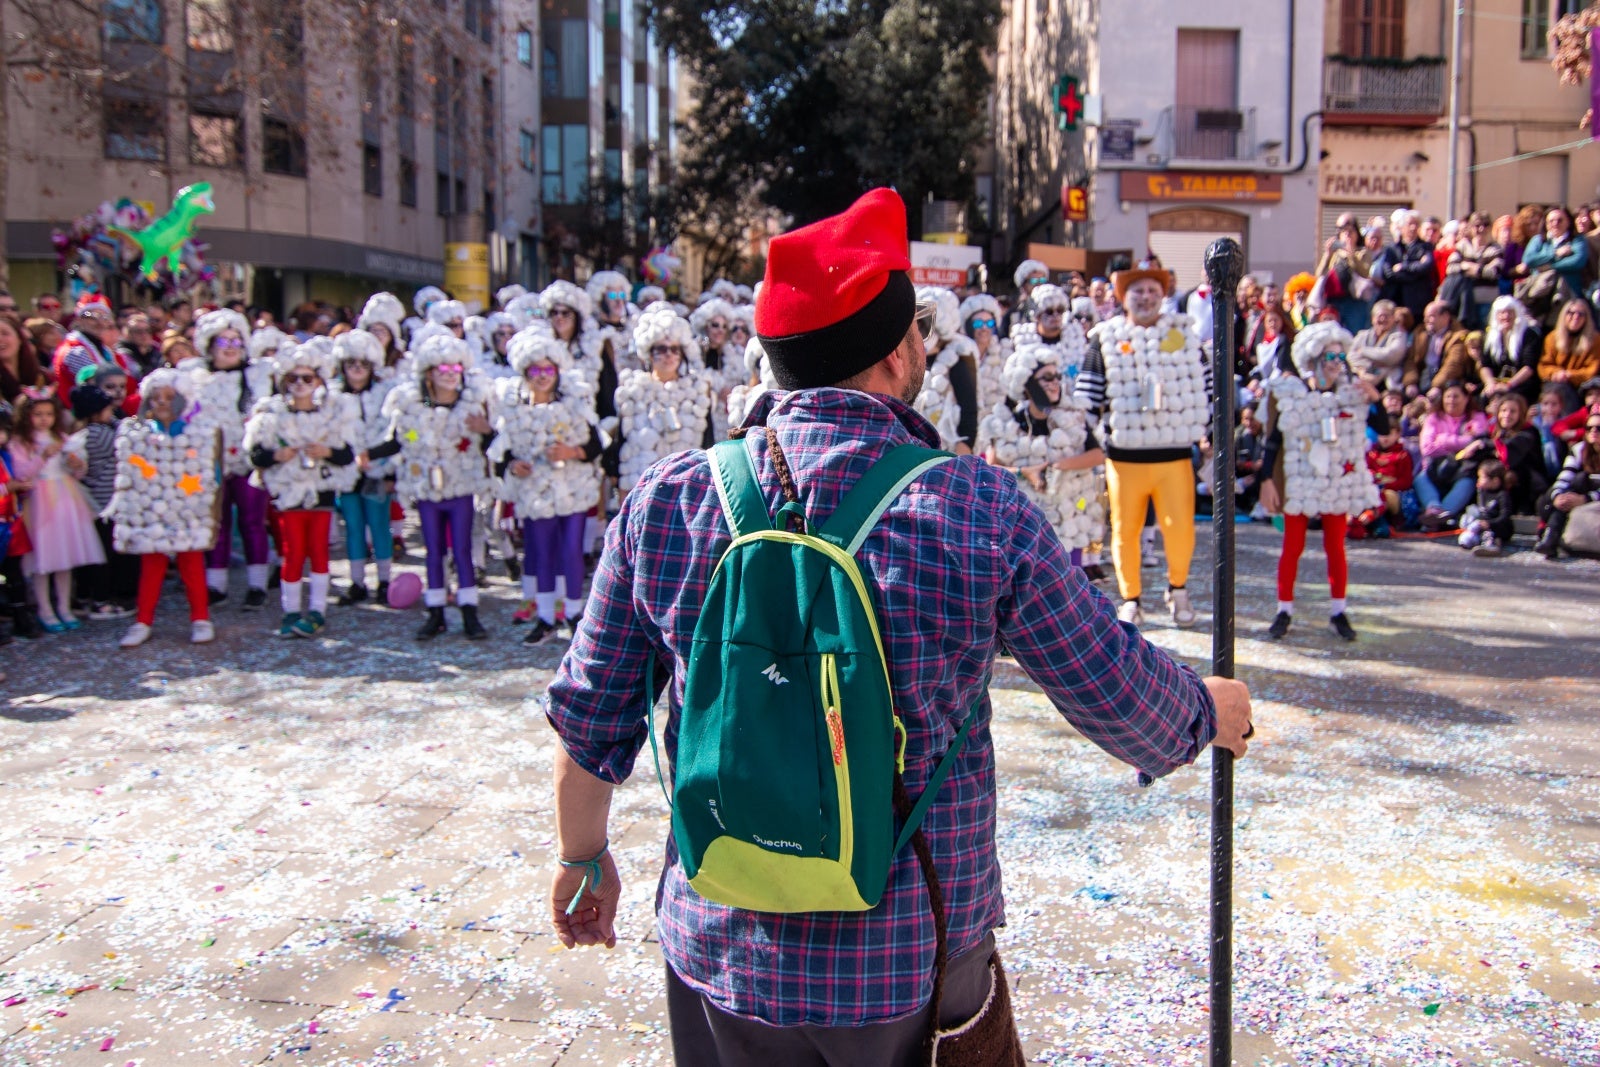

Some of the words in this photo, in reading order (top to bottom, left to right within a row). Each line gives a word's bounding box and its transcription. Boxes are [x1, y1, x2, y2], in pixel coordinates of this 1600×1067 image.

[1181, 175, 1257, 191] TABACS
[1325, 174, 1409, 194] FARMACIA
[752, 834, 803, 851] Quechua
